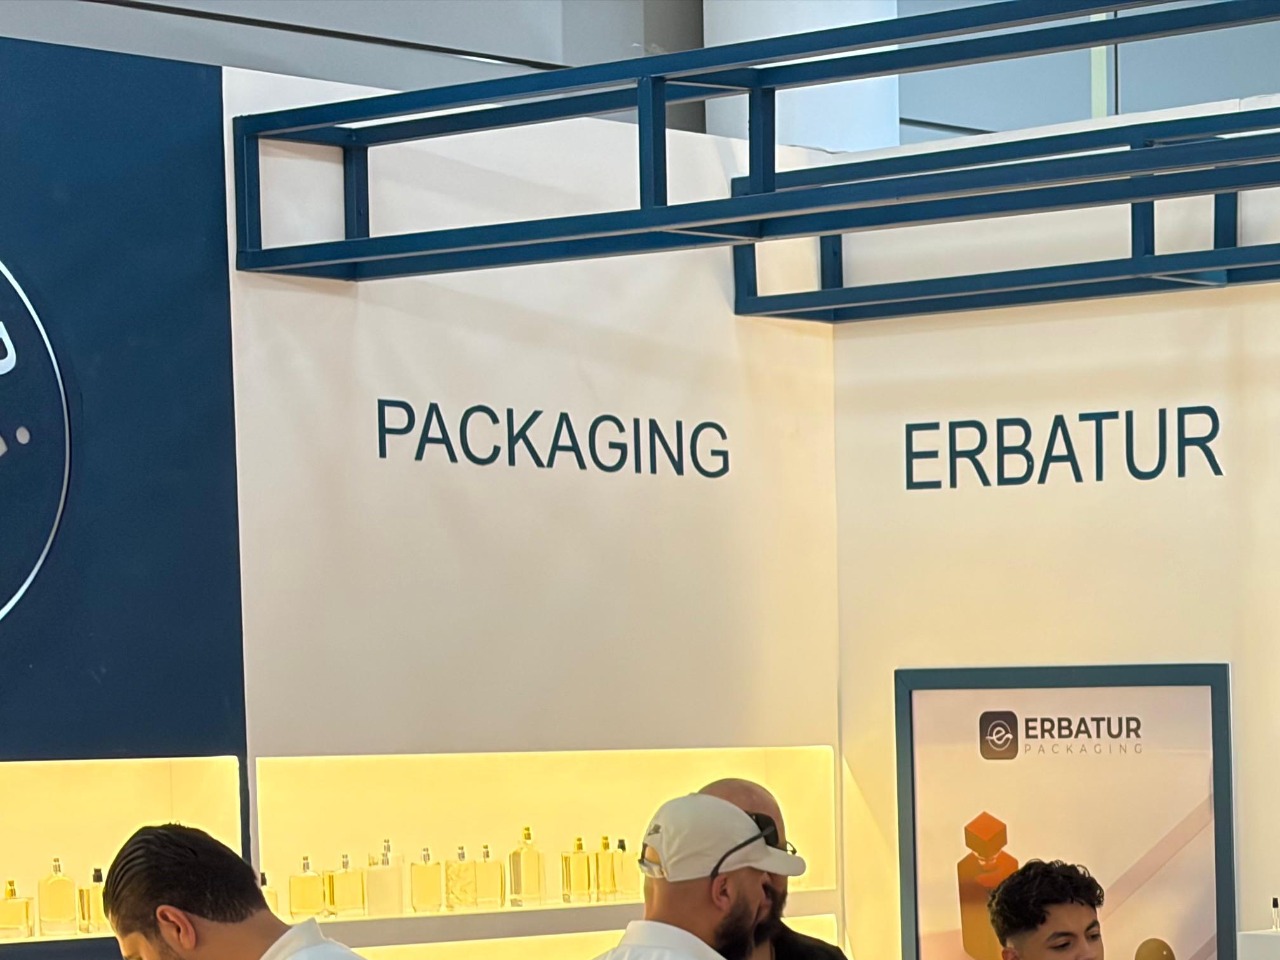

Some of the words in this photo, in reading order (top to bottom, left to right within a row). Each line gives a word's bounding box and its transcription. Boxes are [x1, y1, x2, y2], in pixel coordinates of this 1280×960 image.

[376, 398, 730, 478] PACKAGING
[905, 405, 1224, 490] ERBATUR
[1024, 716, 1142, 739] ERBATUR
[1024, 743, 1143, 755] PACKAGING
